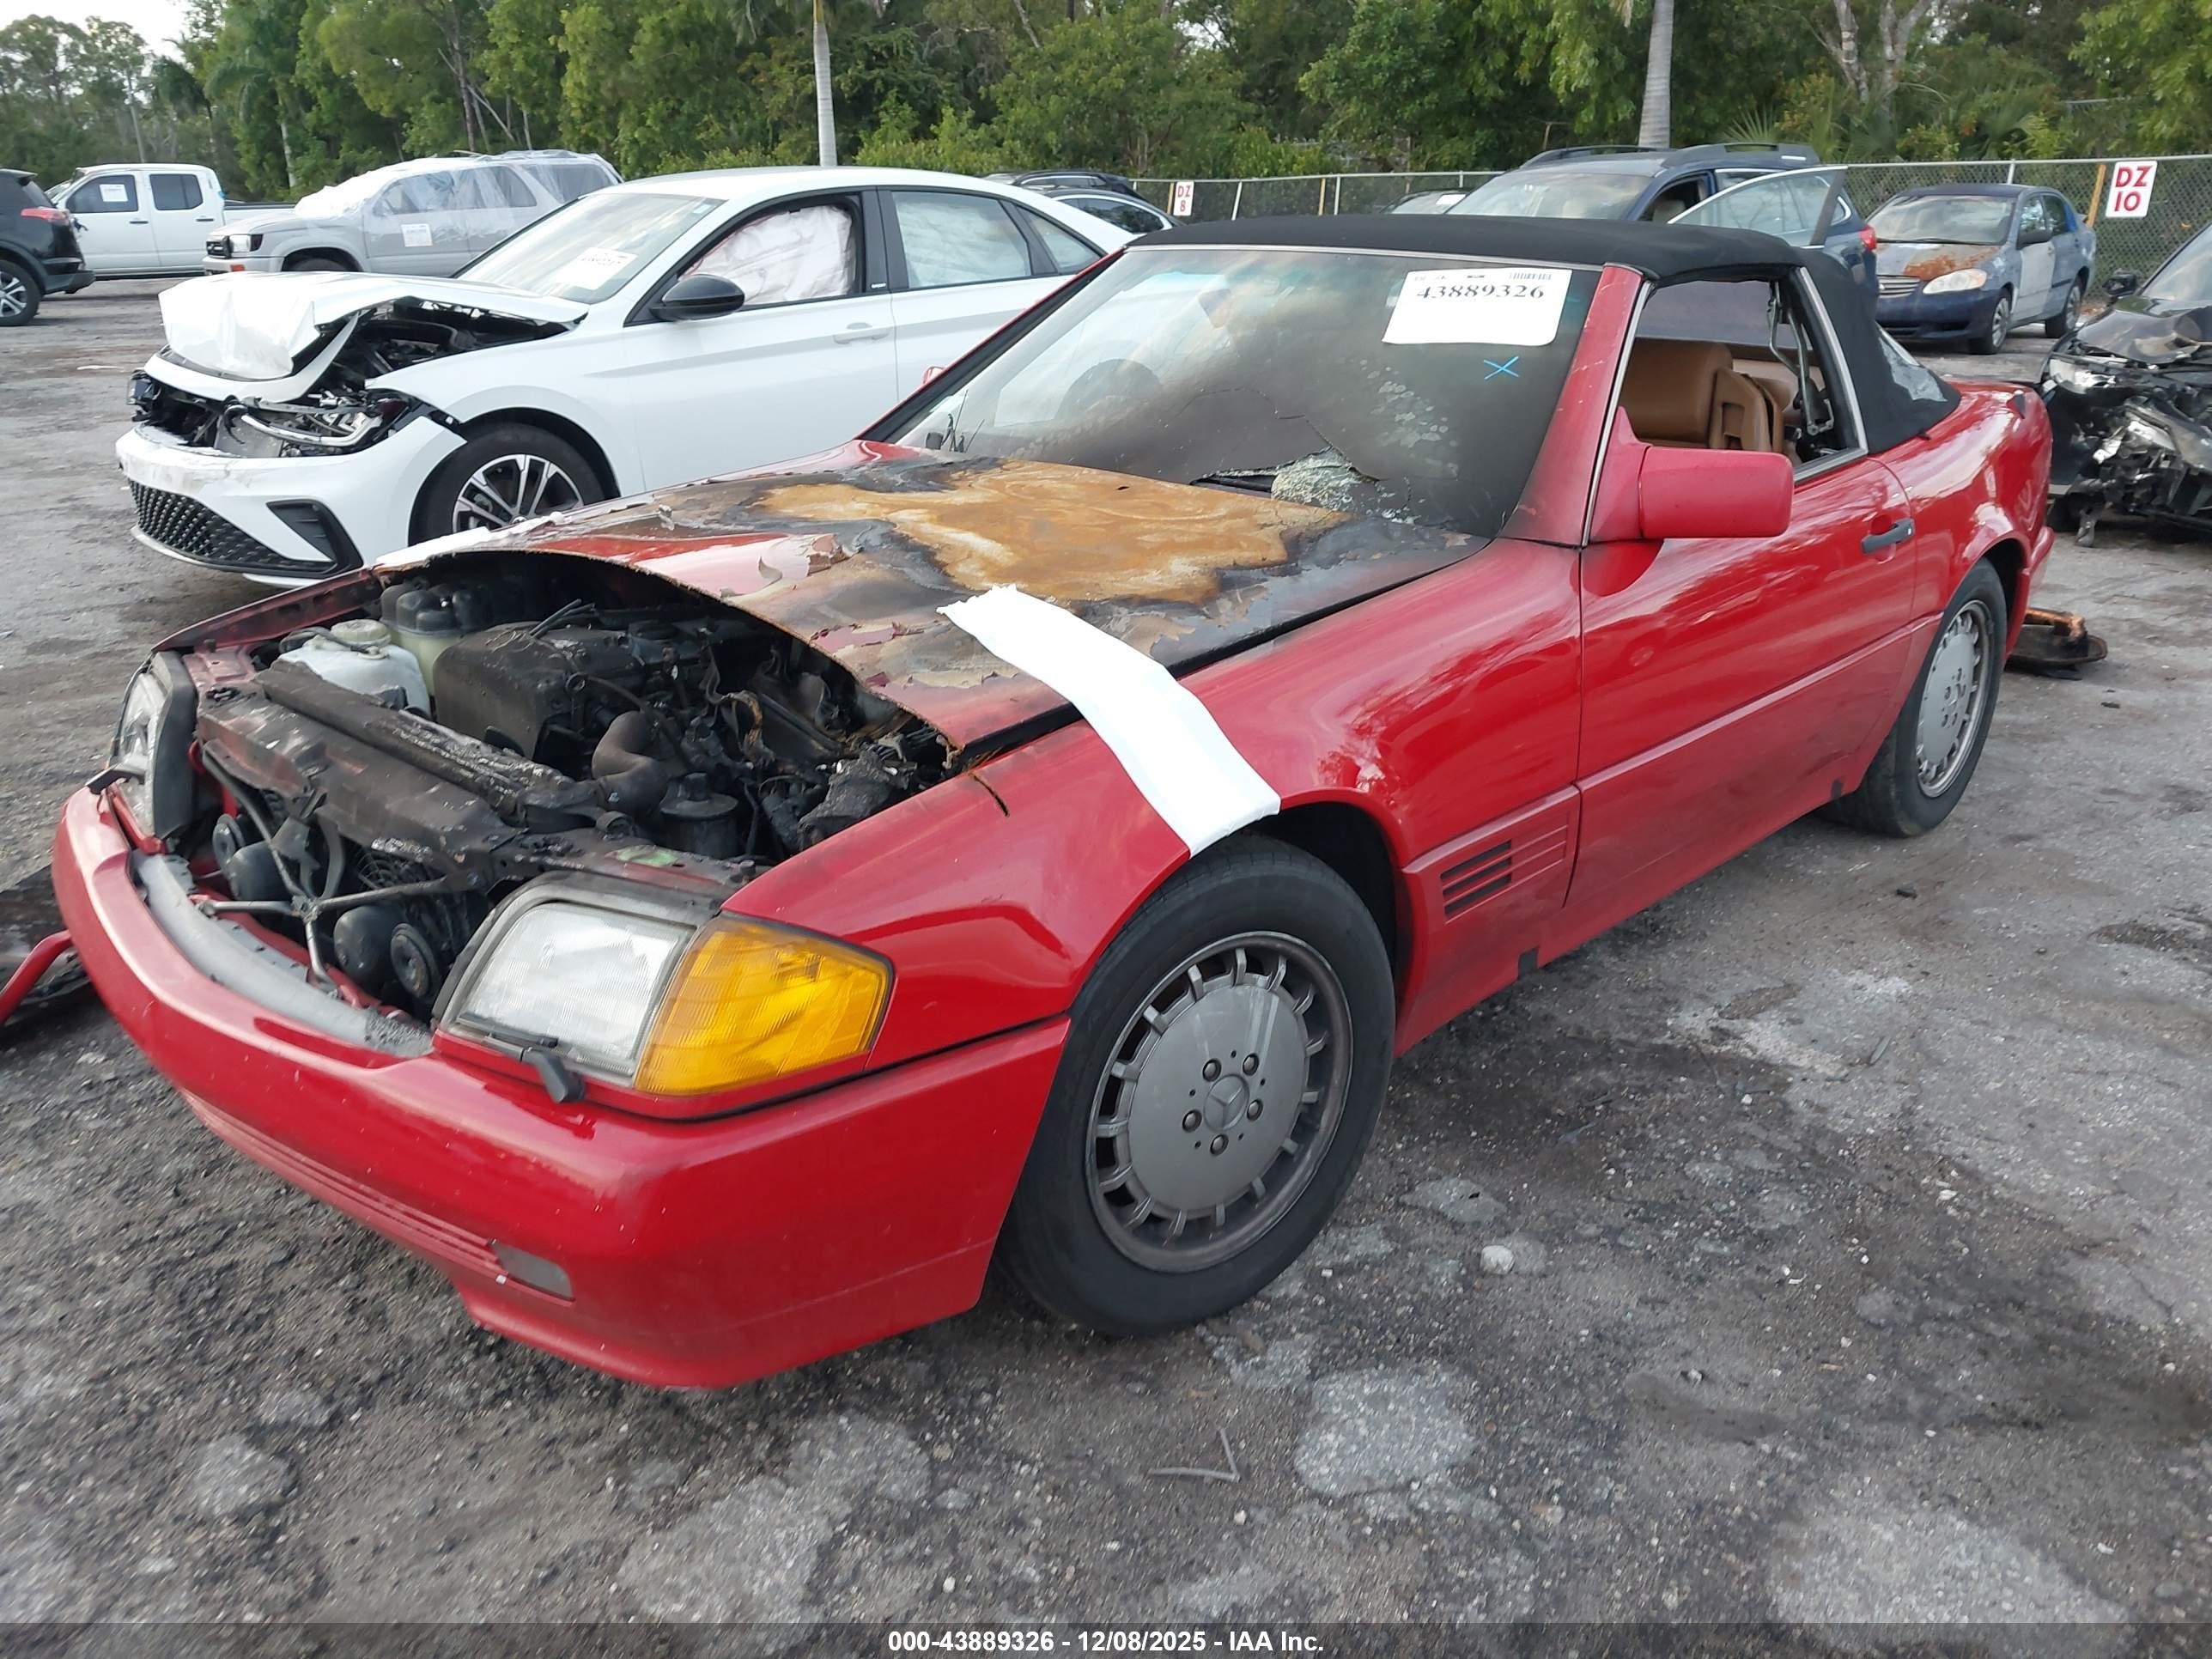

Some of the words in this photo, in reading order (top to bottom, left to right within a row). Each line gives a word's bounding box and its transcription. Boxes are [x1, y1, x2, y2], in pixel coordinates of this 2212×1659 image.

[2115, 166, 2153, 187] DZ
[1177, 185, 1191, 198] DZ
[1180, 199, 1186, 212] 8
[1417, 284, 1545, 299] 43889326
